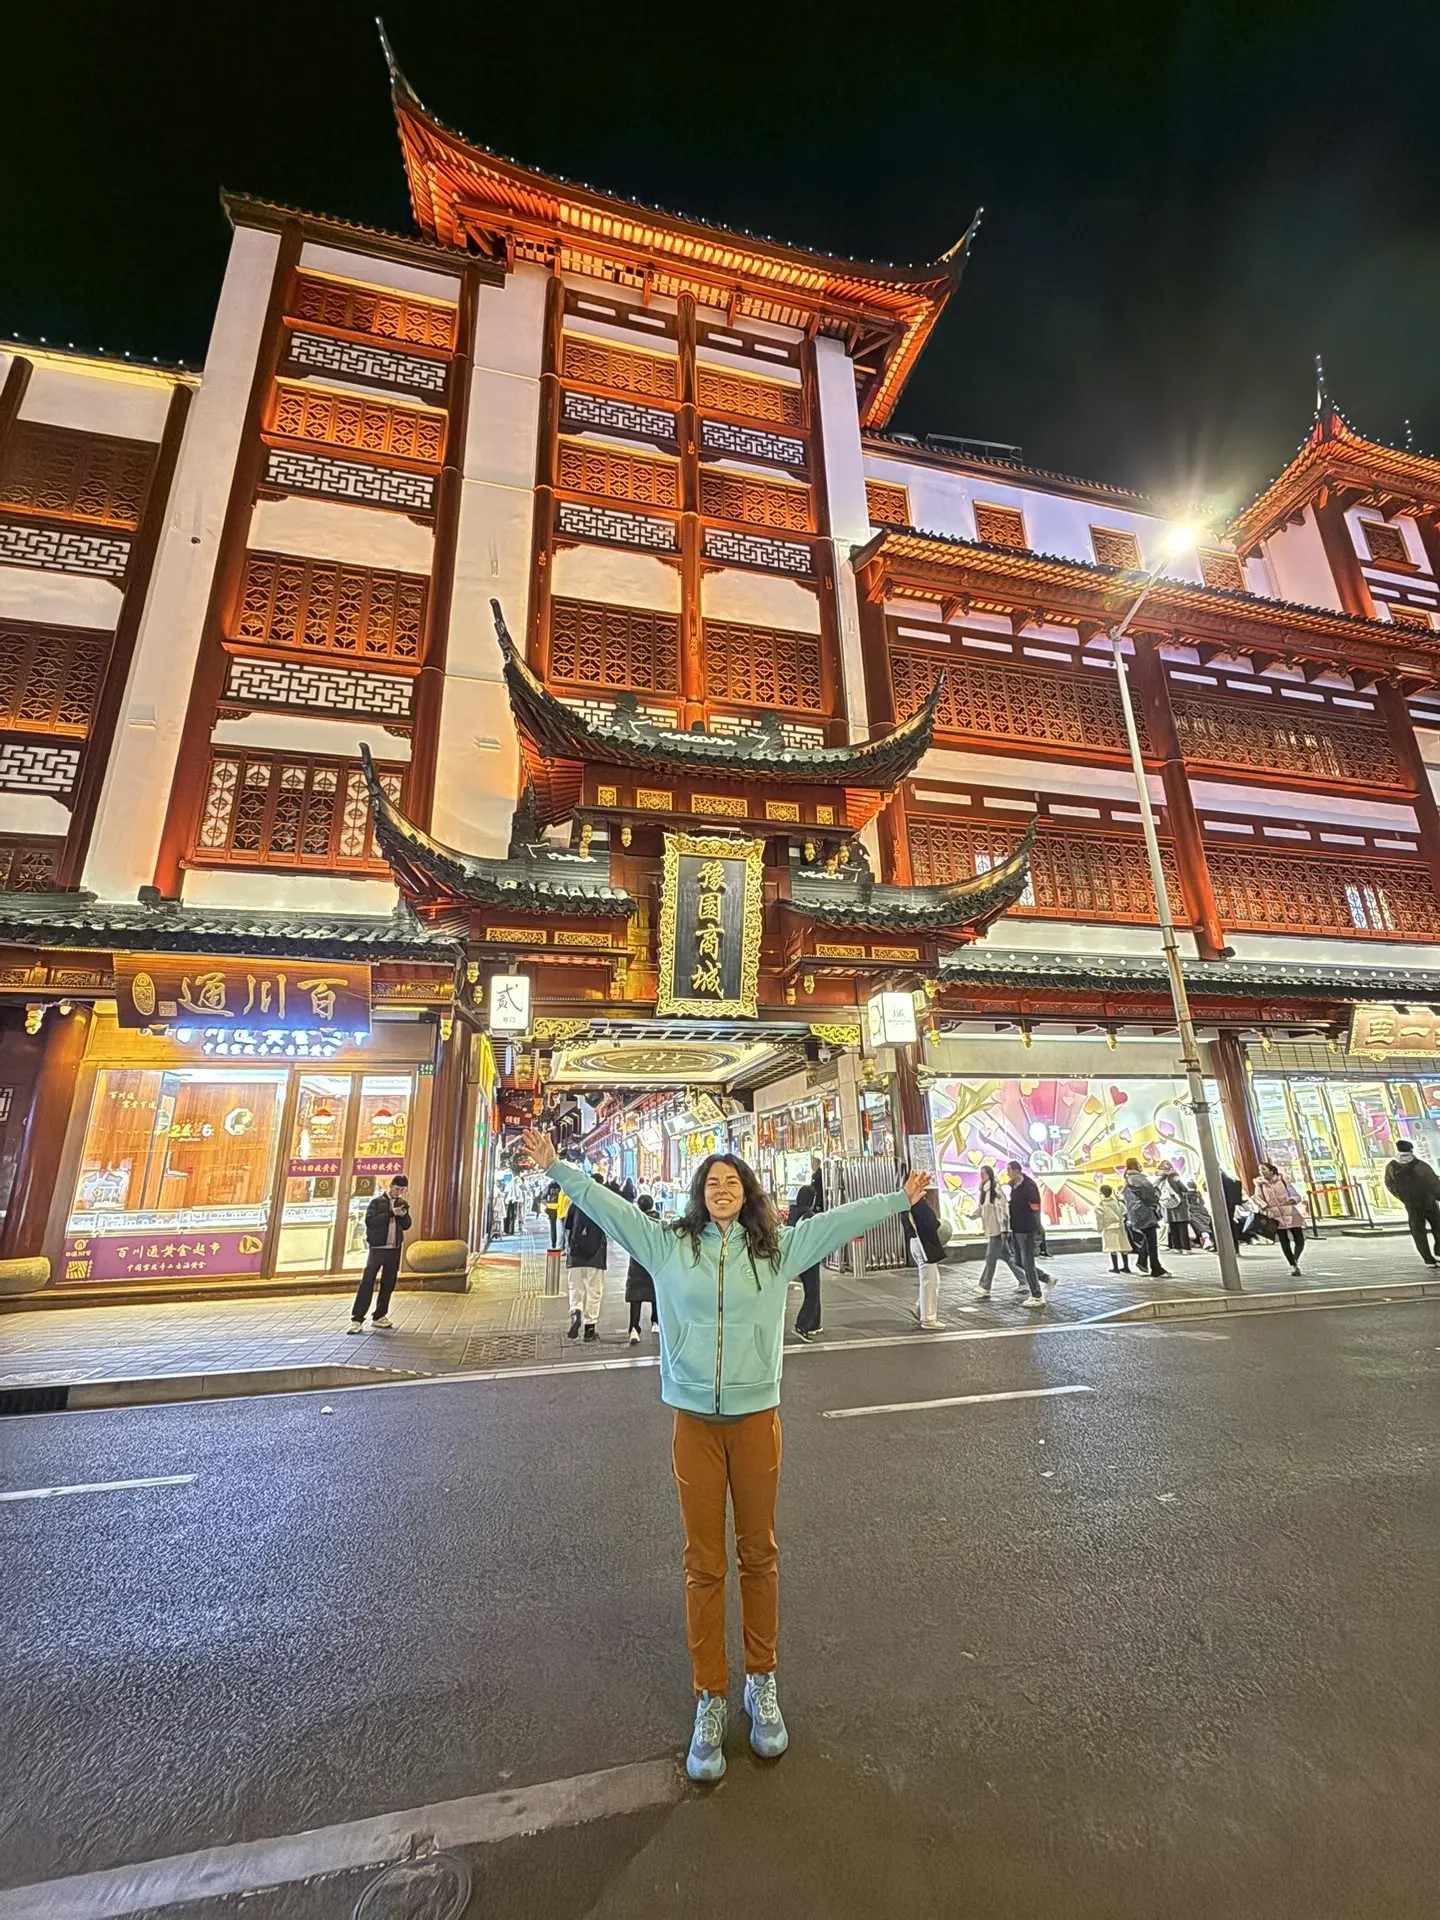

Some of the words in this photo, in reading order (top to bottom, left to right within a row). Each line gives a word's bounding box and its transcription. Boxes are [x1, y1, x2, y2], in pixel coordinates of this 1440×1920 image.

[177, 971, 348, 1021] 百川通
[116, 1241, 221, 1260] 百川通黄金超市
